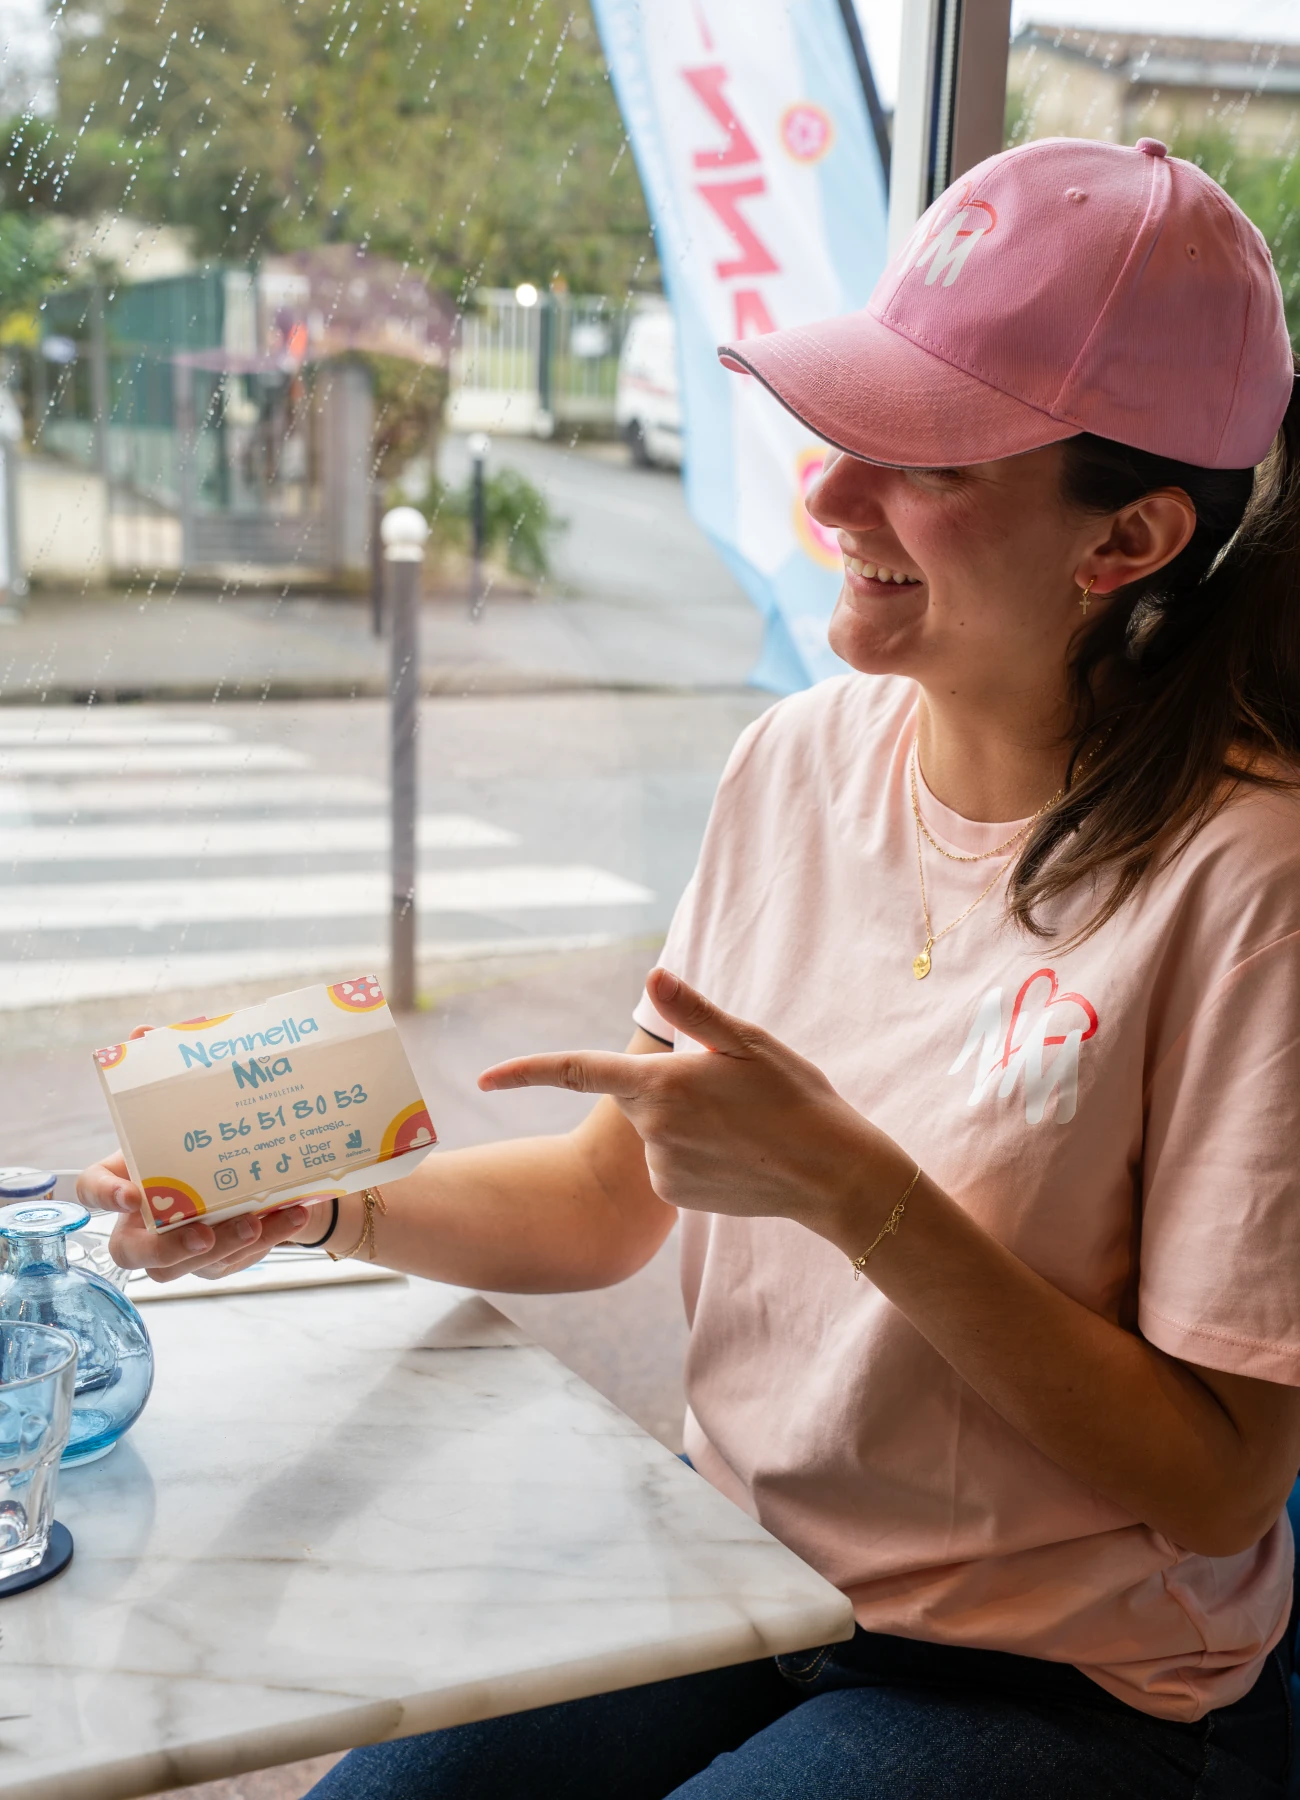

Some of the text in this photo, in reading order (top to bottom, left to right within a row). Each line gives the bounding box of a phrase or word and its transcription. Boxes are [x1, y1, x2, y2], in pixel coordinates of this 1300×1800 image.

[177, 1016, 319, 1069] Nennella
[231, 1055, 293, 1089] Mia
[235, 1083, 305, 1108] PIZZA NAPOLETANA
[183, 1083, 368, 1153] 05 56 51 80 53
[253, 1136, 286, 1152] amore
[289, 1133, 297, 1142] e
[298, 1140, 332, 1156] Uber
[302, 1152, 337, 1169] Eats
